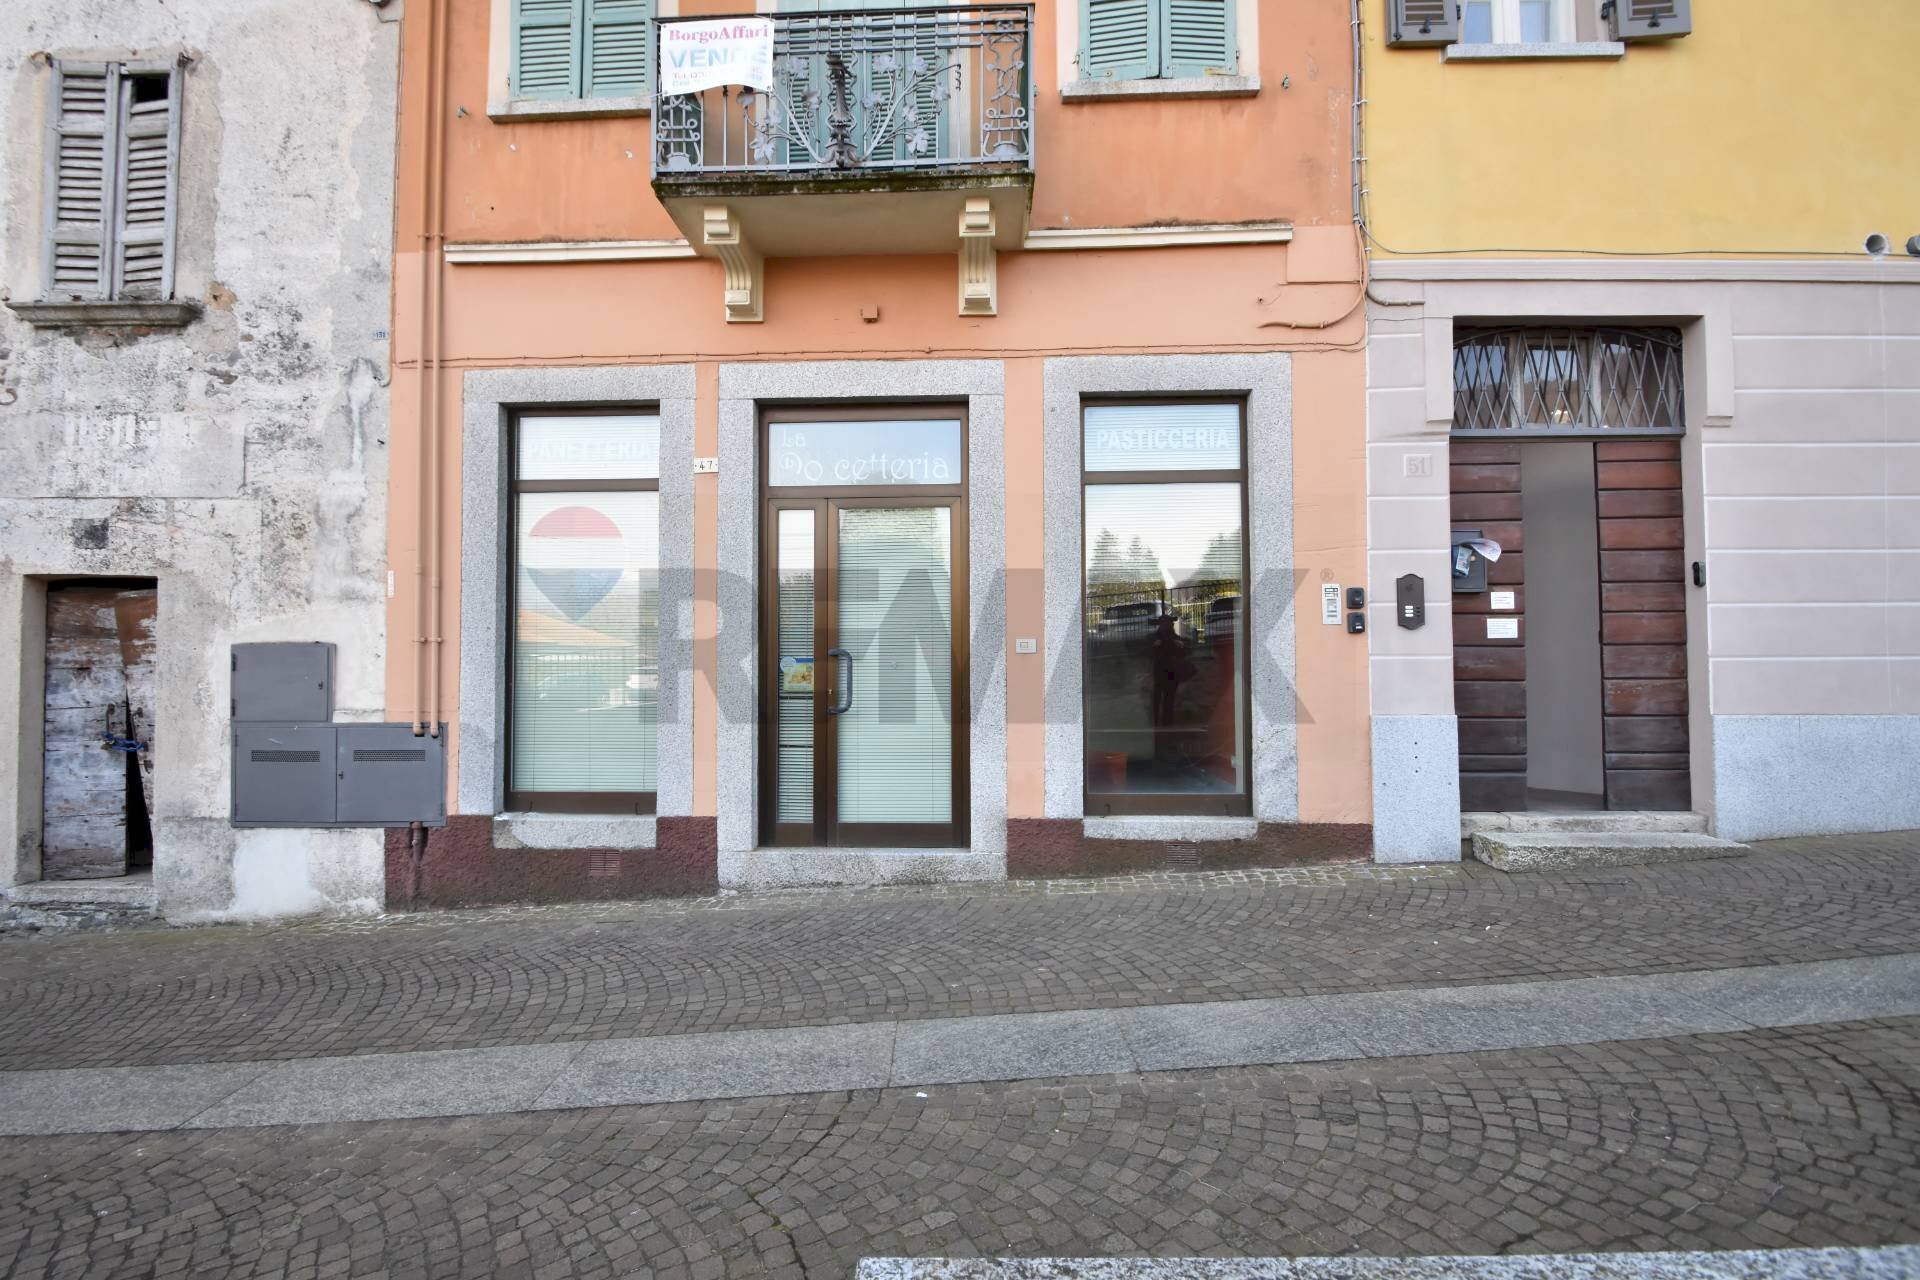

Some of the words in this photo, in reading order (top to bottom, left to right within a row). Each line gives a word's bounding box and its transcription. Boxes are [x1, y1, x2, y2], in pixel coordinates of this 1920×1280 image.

[669, 25, 769, 43] BorgoAffari
[781, 428, 806, 447] La
[1096, 428, 1230, 449] PASTICCERIA
[1409, 457, 1425, 474] 51
